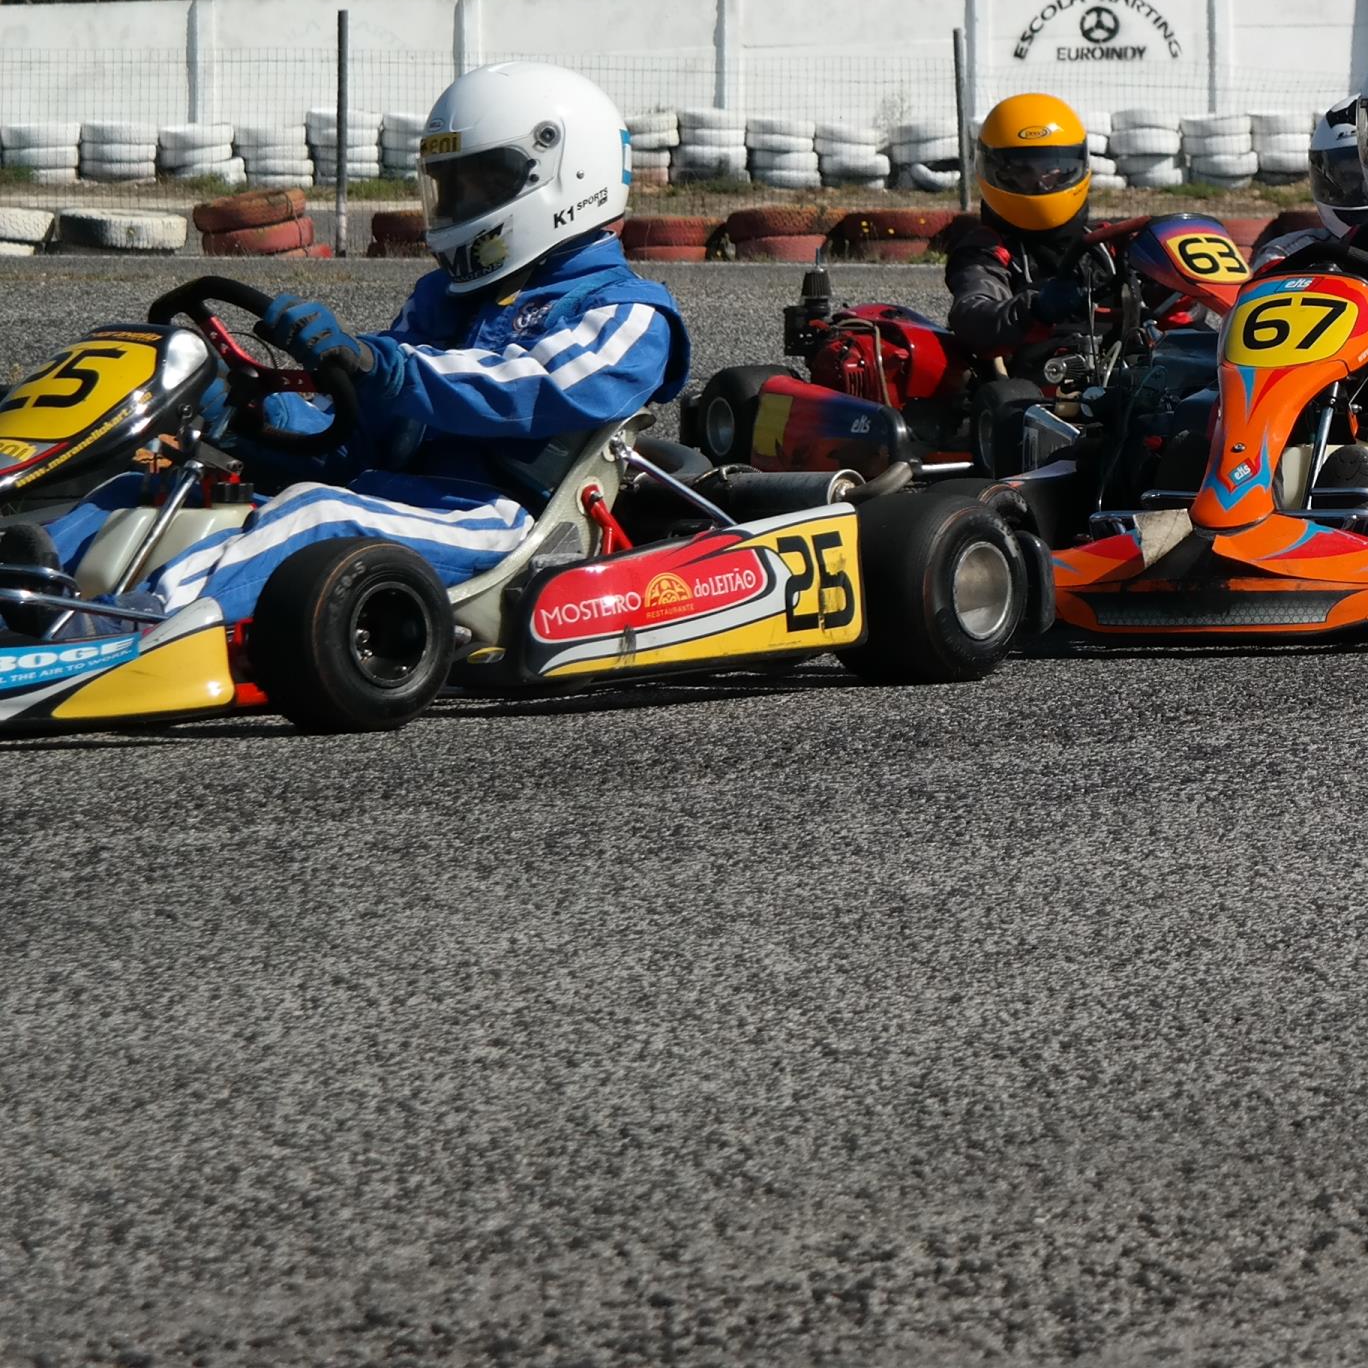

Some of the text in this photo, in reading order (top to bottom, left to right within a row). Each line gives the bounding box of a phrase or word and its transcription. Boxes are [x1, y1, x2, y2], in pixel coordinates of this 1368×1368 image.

[1056, 45, 1147, 62] EUROINDY
[553, 205, 575, 229] K1
[576, 186, 608, 211] SPORTS
[1178, 236, 1248, 275] 63
[1242, 297, 1348, 350] 67
[776, 531, 855, 632] 25
[541, 590, 642, 634] MOSTEIRO
[645, 602, 695, 619] RESTAURANTE
[11, 672, 37, 683] THE
[39, 667, 64, 679] AIR
[66, 661, 86, 672] TO
